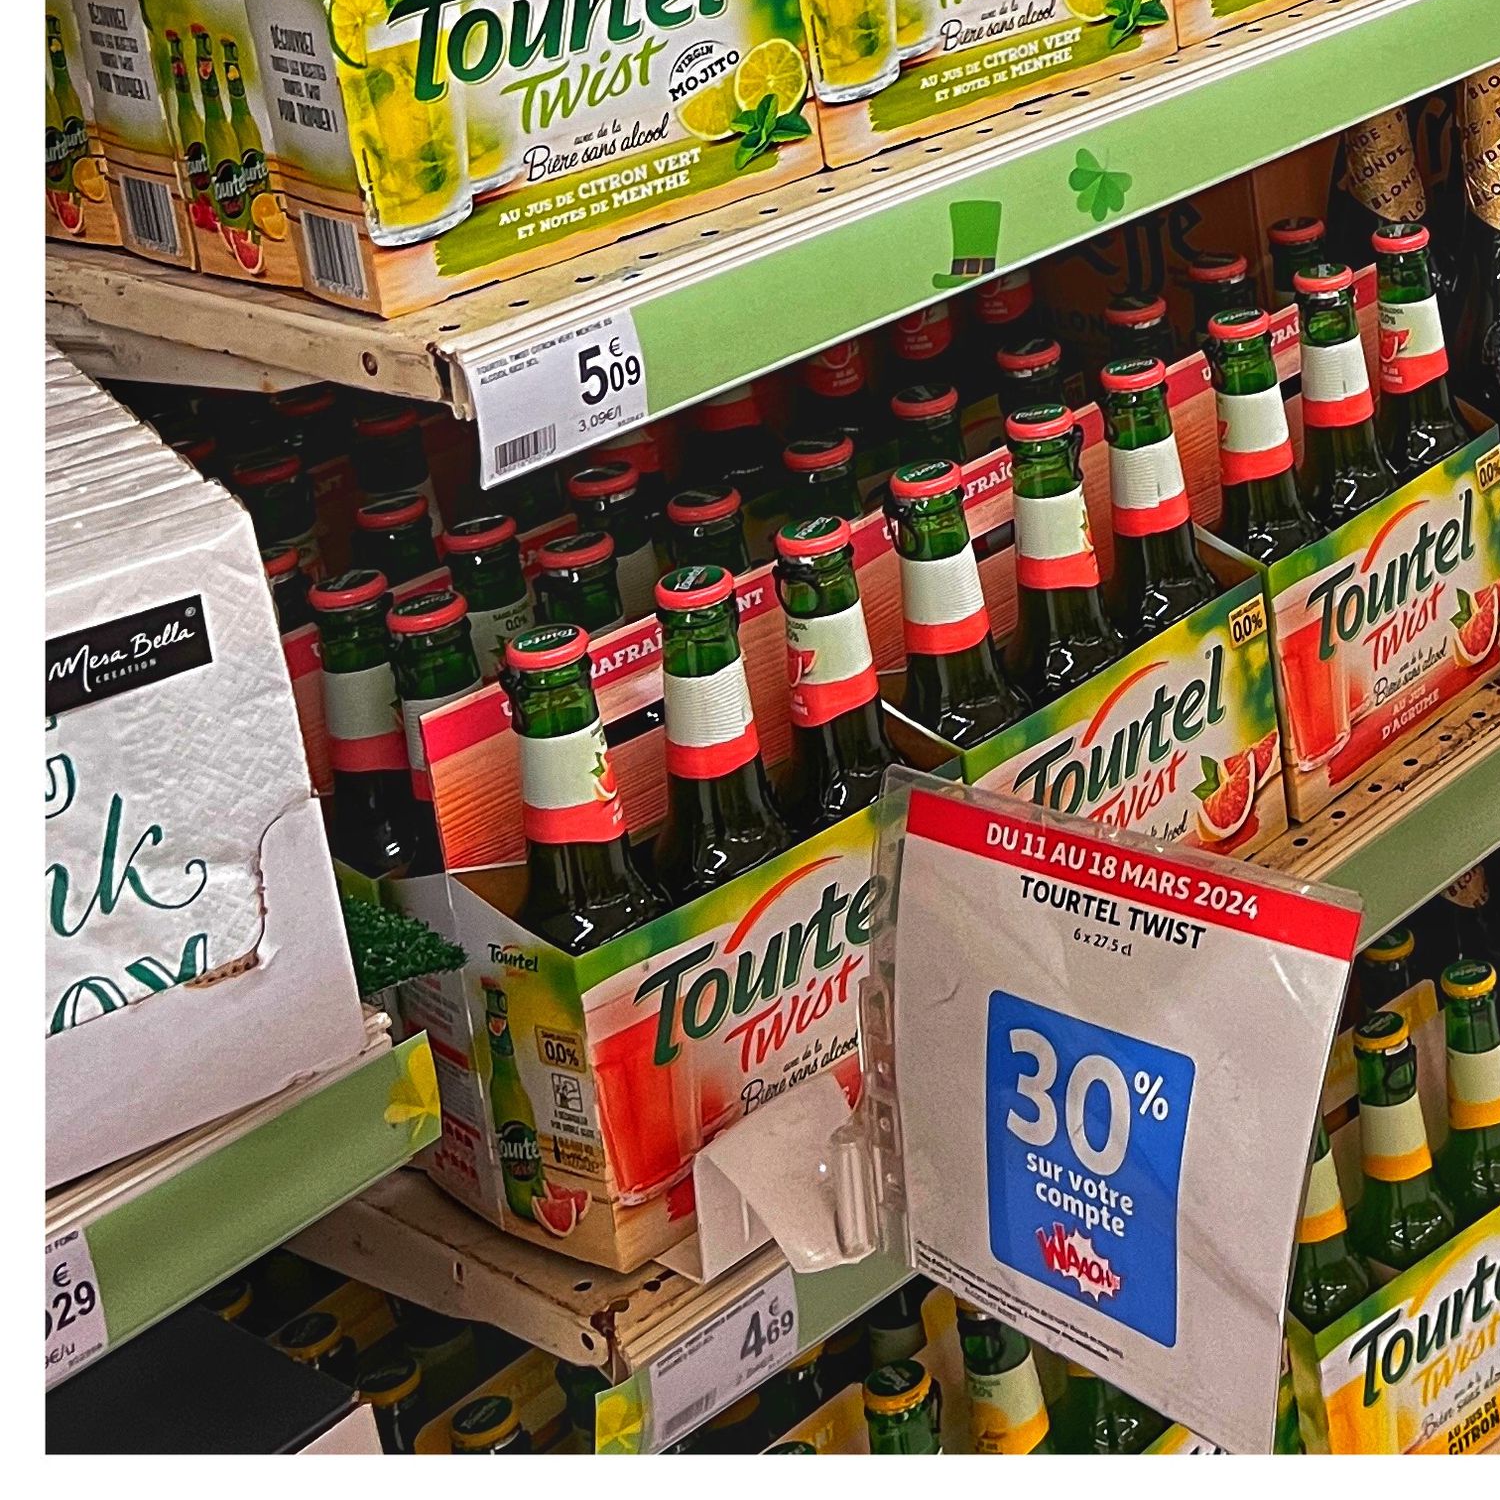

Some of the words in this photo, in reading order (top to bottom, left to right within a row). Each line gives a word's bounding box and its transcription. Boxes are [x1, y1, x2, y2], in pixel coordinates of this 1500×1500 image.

[501, 35, 668, 136] Twist
[668, 50, 741, 104] MOJITO
[523, 145, 579, 182] Bière
[581, 140, 616, 164] sans
[621, 112, 670, 151] alcool
[499, 209, 521, 226] AU
[524, 200, 553, 217] JUS
[556, 192, 575, 208] DE
[578, 164, 647, 199] CITRON
[653, 148, 702, 175] VERT
[517, 224, 536, 240] ET
[540, 208, 587, 232] NOTES
[590, 200, 610, 217] DE
[612, 170, 690, 208] MENTHE
[1305, 489, 1477, 662] Tourtel
[49, 640, 126, 694] Mesa
[133, 621, 195, 658] Bella
[1362, 582, 1446, 673] Twist
[94, 657, 157, 684] CREATION
[986, 822, 1017, 850] DU
[1021, 833, 1046, 858] 11
[1050, 841, 1087, 871] AU
[1090, 853, 1118, 880] 18
[1120, 863, 1192, 899] MARS
[1197, 882, 1259, 919] 2024
[1019, 874, 1121, 927] TOURTEL
[1127, 907, 1207, 950] TWIST
[1074, 926, 1082, 941] 6
[1093, 931, 1117, 952] 27.5
[1120, 942, 1132, 957] cl
[1025, 1151, 1063, 1182] sur
[1068, 1170, 1134, 1217] votre
[1035, 1179, 1125, 1238] compte
